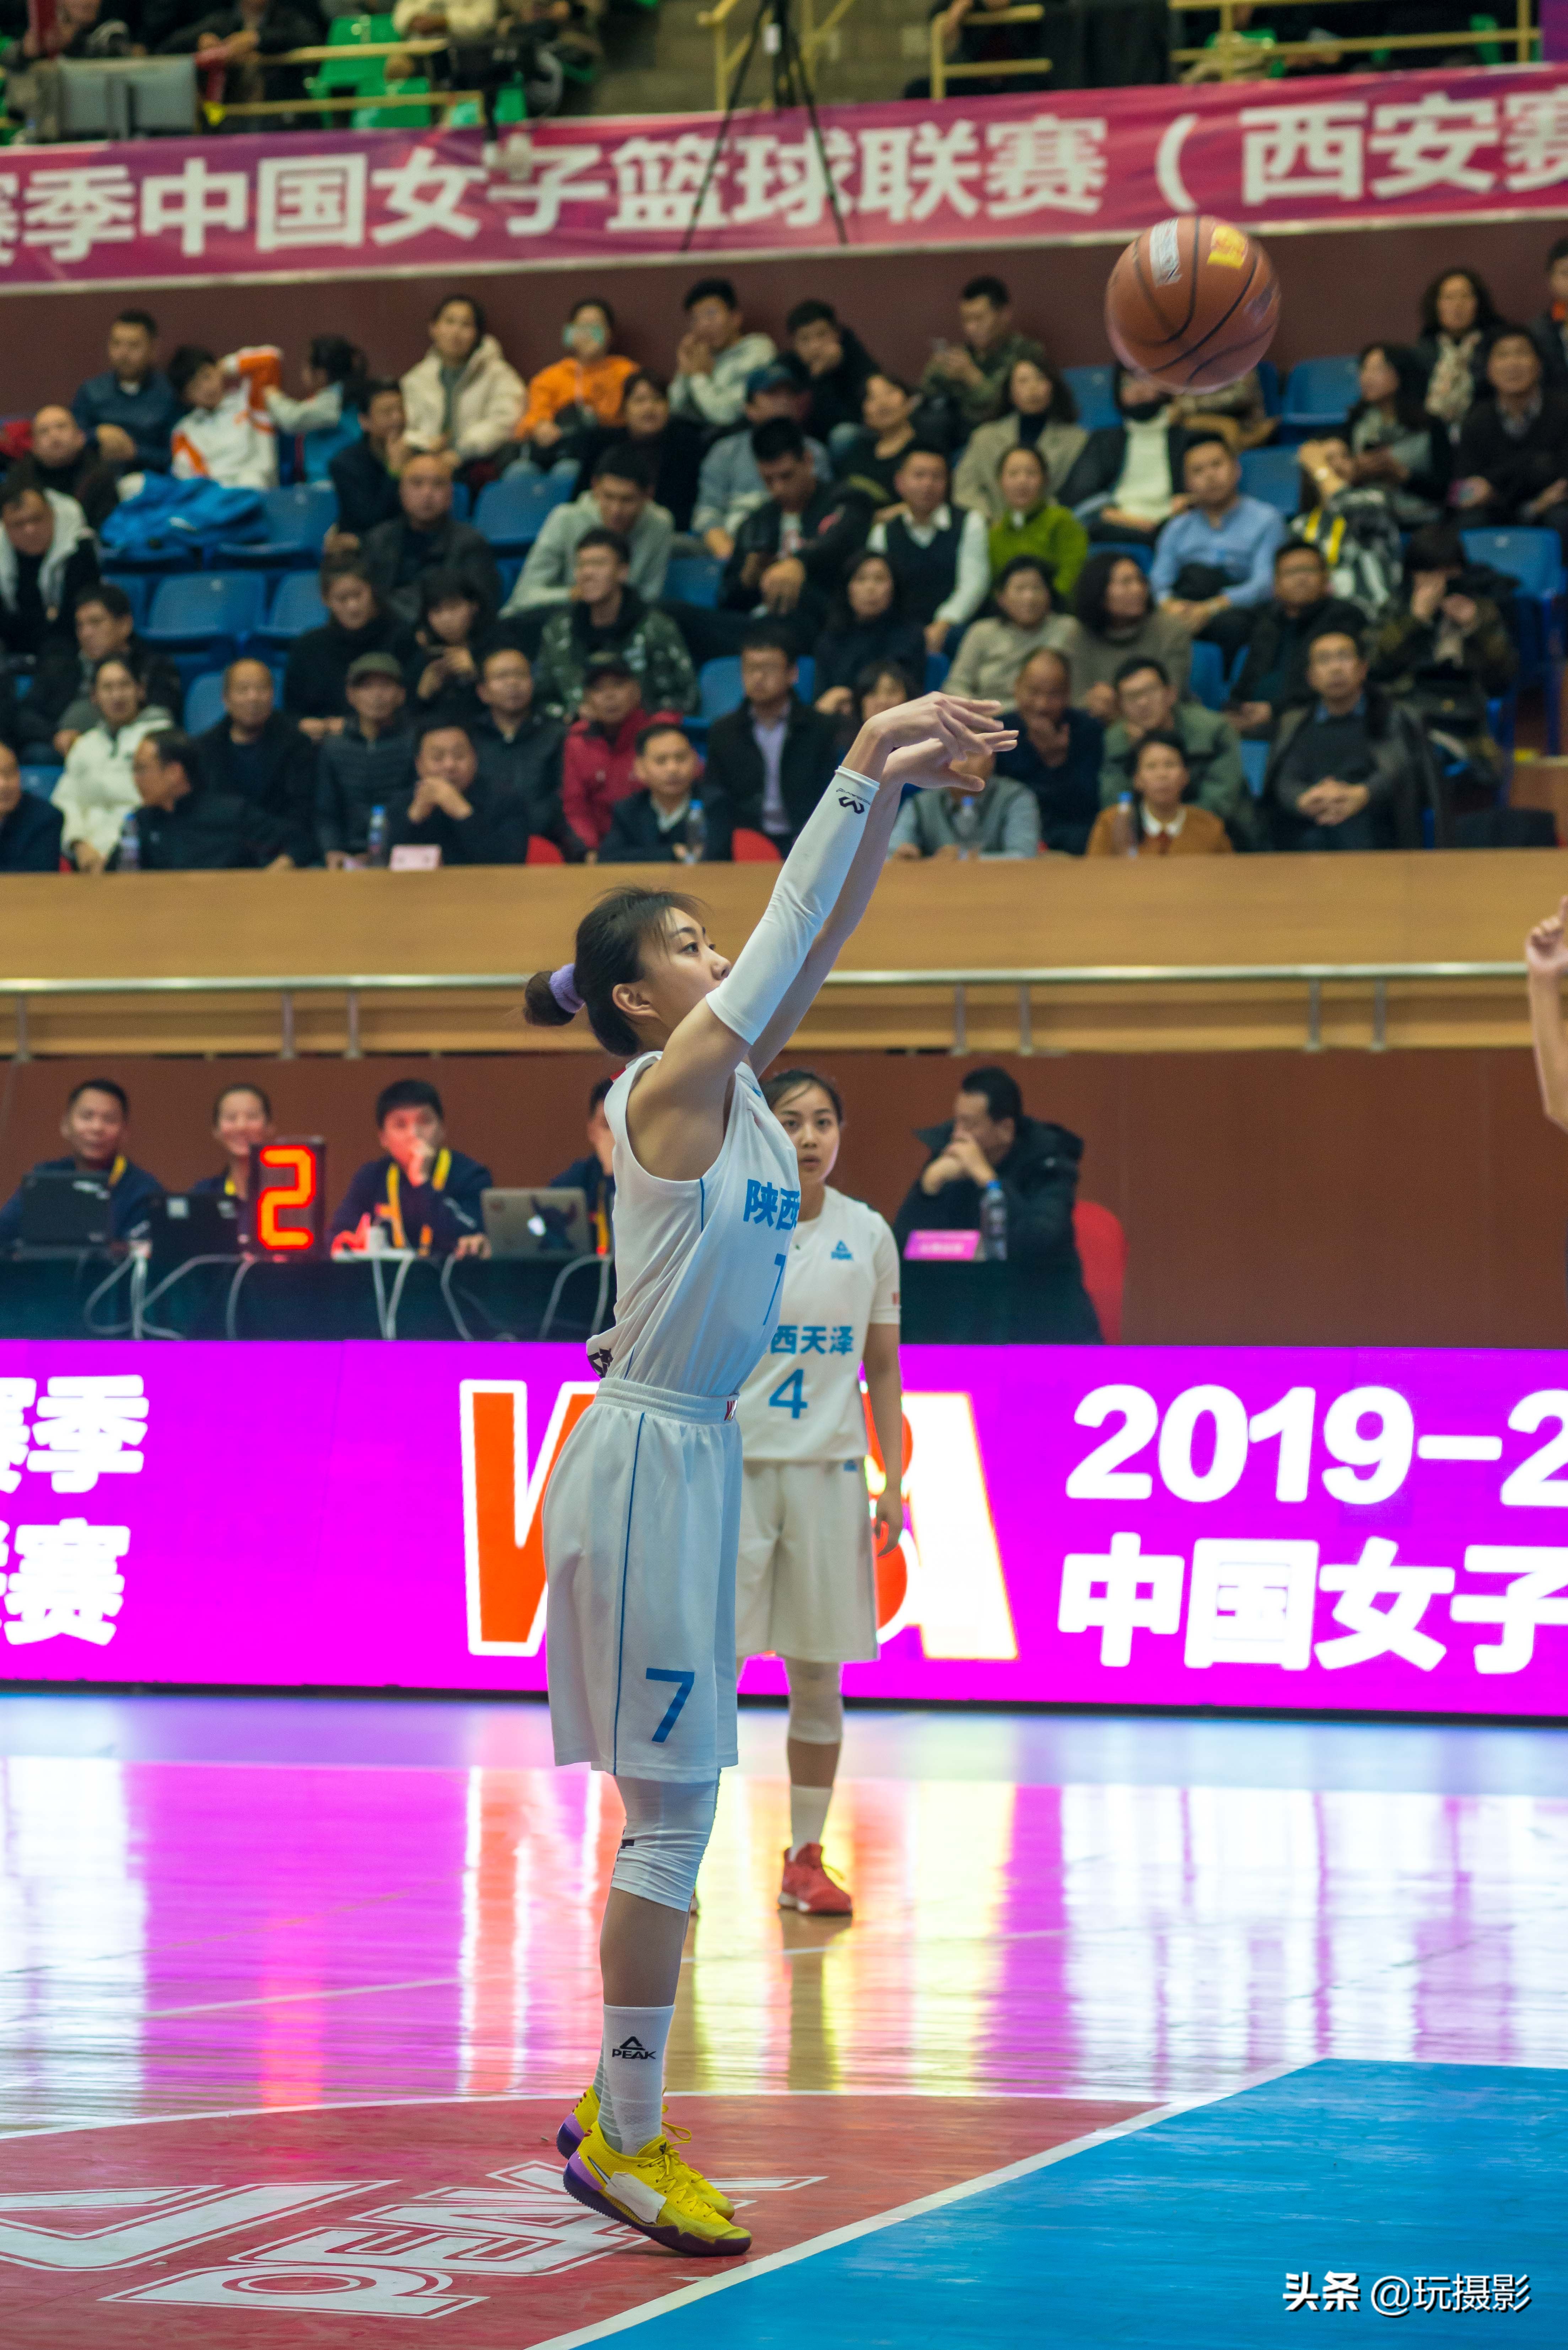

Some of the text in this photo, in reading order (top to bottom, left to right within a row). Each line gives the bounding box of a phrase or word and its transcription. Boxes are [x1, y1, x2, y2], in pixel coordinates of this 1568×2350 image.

[0, 85, 1568, 267] 季中国女子篮球联赛（西安赛
[258, 1144, 316, 1250] 2
[768, 1368, 808, 1419] 4
[0, 1517, 131, 1646] 赛
[1057, 1532, 1568, 1674] 中国女子
[645, 1667, 695, 1743] 7
[612, 2049, 657, 2060] PEAK
